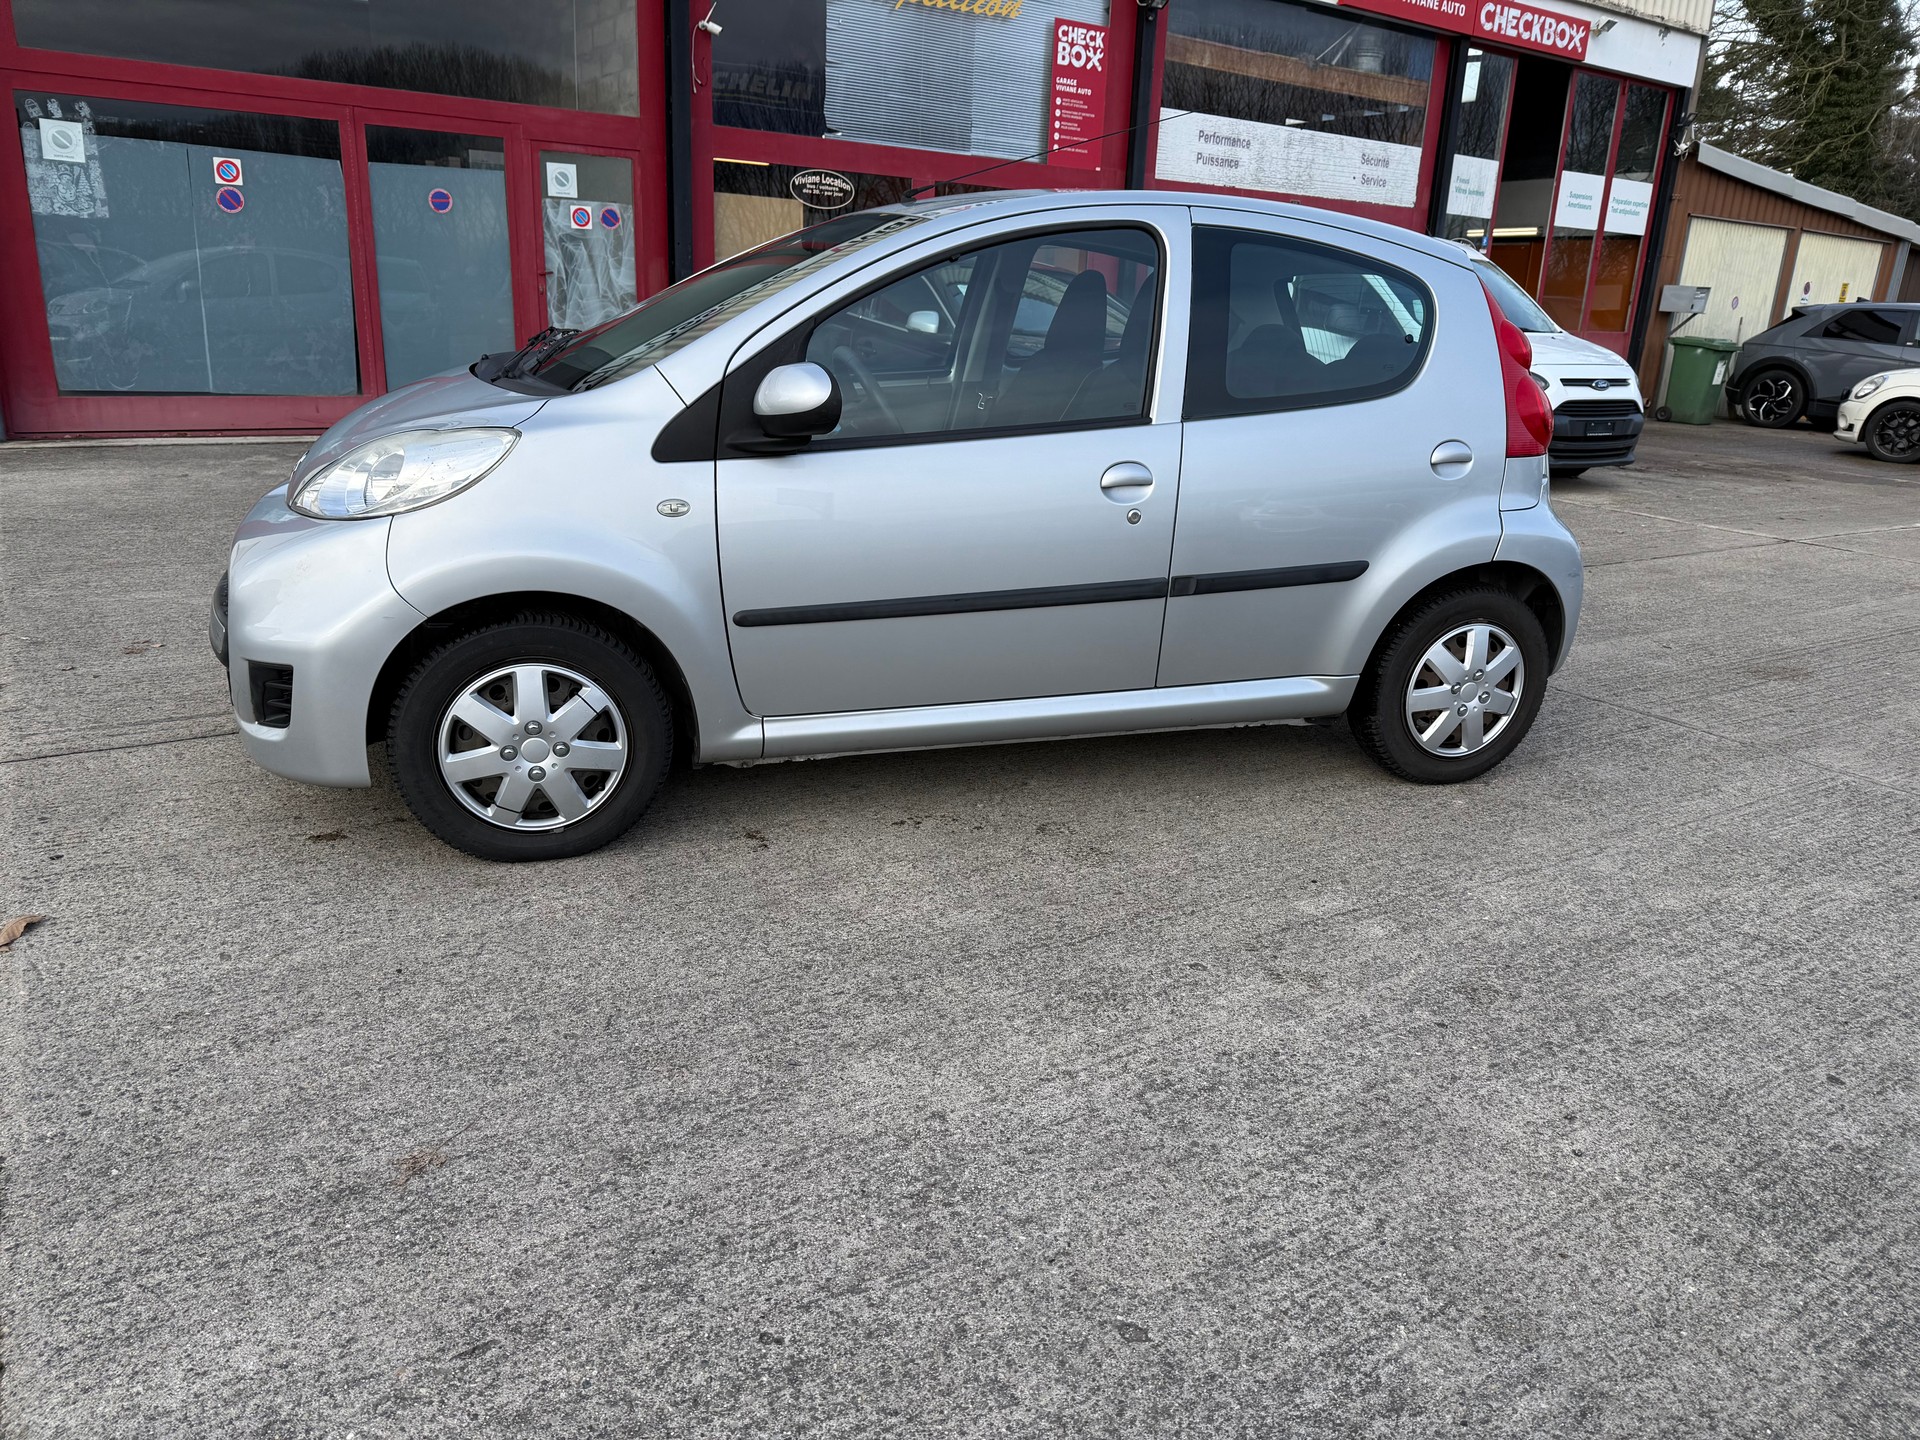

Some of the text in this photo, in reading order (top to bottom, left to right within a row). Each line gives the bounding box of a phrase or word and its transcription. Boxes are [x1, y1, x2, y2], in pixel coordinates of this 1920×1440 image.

[1441, 0, 1466, 17] AUTO
[1058, 24, 1105, 49] CHECK
[1479, 2, 1587, 54] CHECKBOX
[1056, 41, 1105, 72] BOX
[1055, 76, 1078, 87] GARAGE
[1055, 84, 1092, 96] VIVIANE AUTO
[1198, 129, 1251, 149] Performance
[1196, 151, 1240, 169] Puissance
[1361, 153, 1390, 169] Sécurité
[794, 173, 851, 192] Viviane Location
[1361, 173, 1387, 188] Service
[1569, 190, 1592, 201] Suspensions
